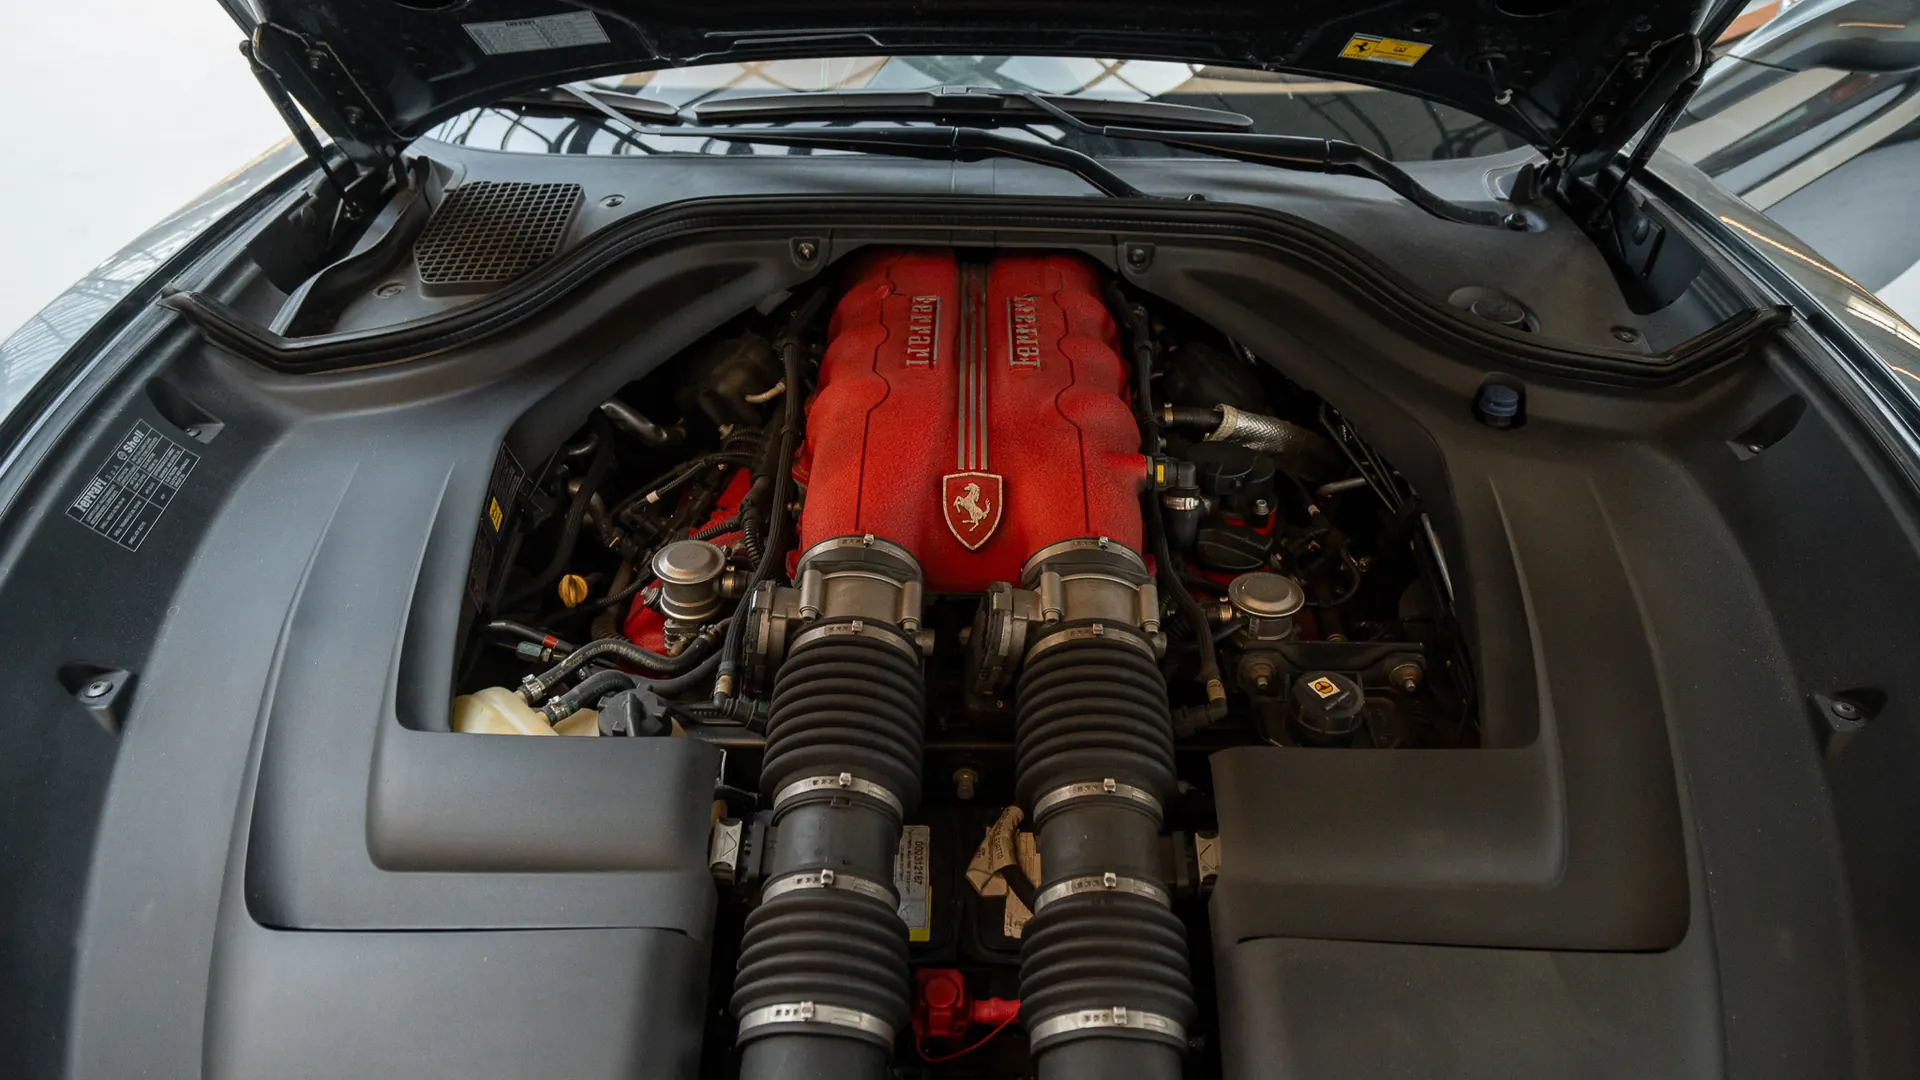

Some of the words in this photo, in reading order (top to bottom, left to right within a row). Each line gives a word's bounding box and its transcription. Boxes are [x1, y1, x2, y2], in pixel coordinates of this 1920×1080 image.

[906, 296, 941, 366] Ferrari
[1006, 295, 1041, 366] Ferrari
[74, 477, 107, 512] Ferrari
[123, 429, 145, 453] Shell
